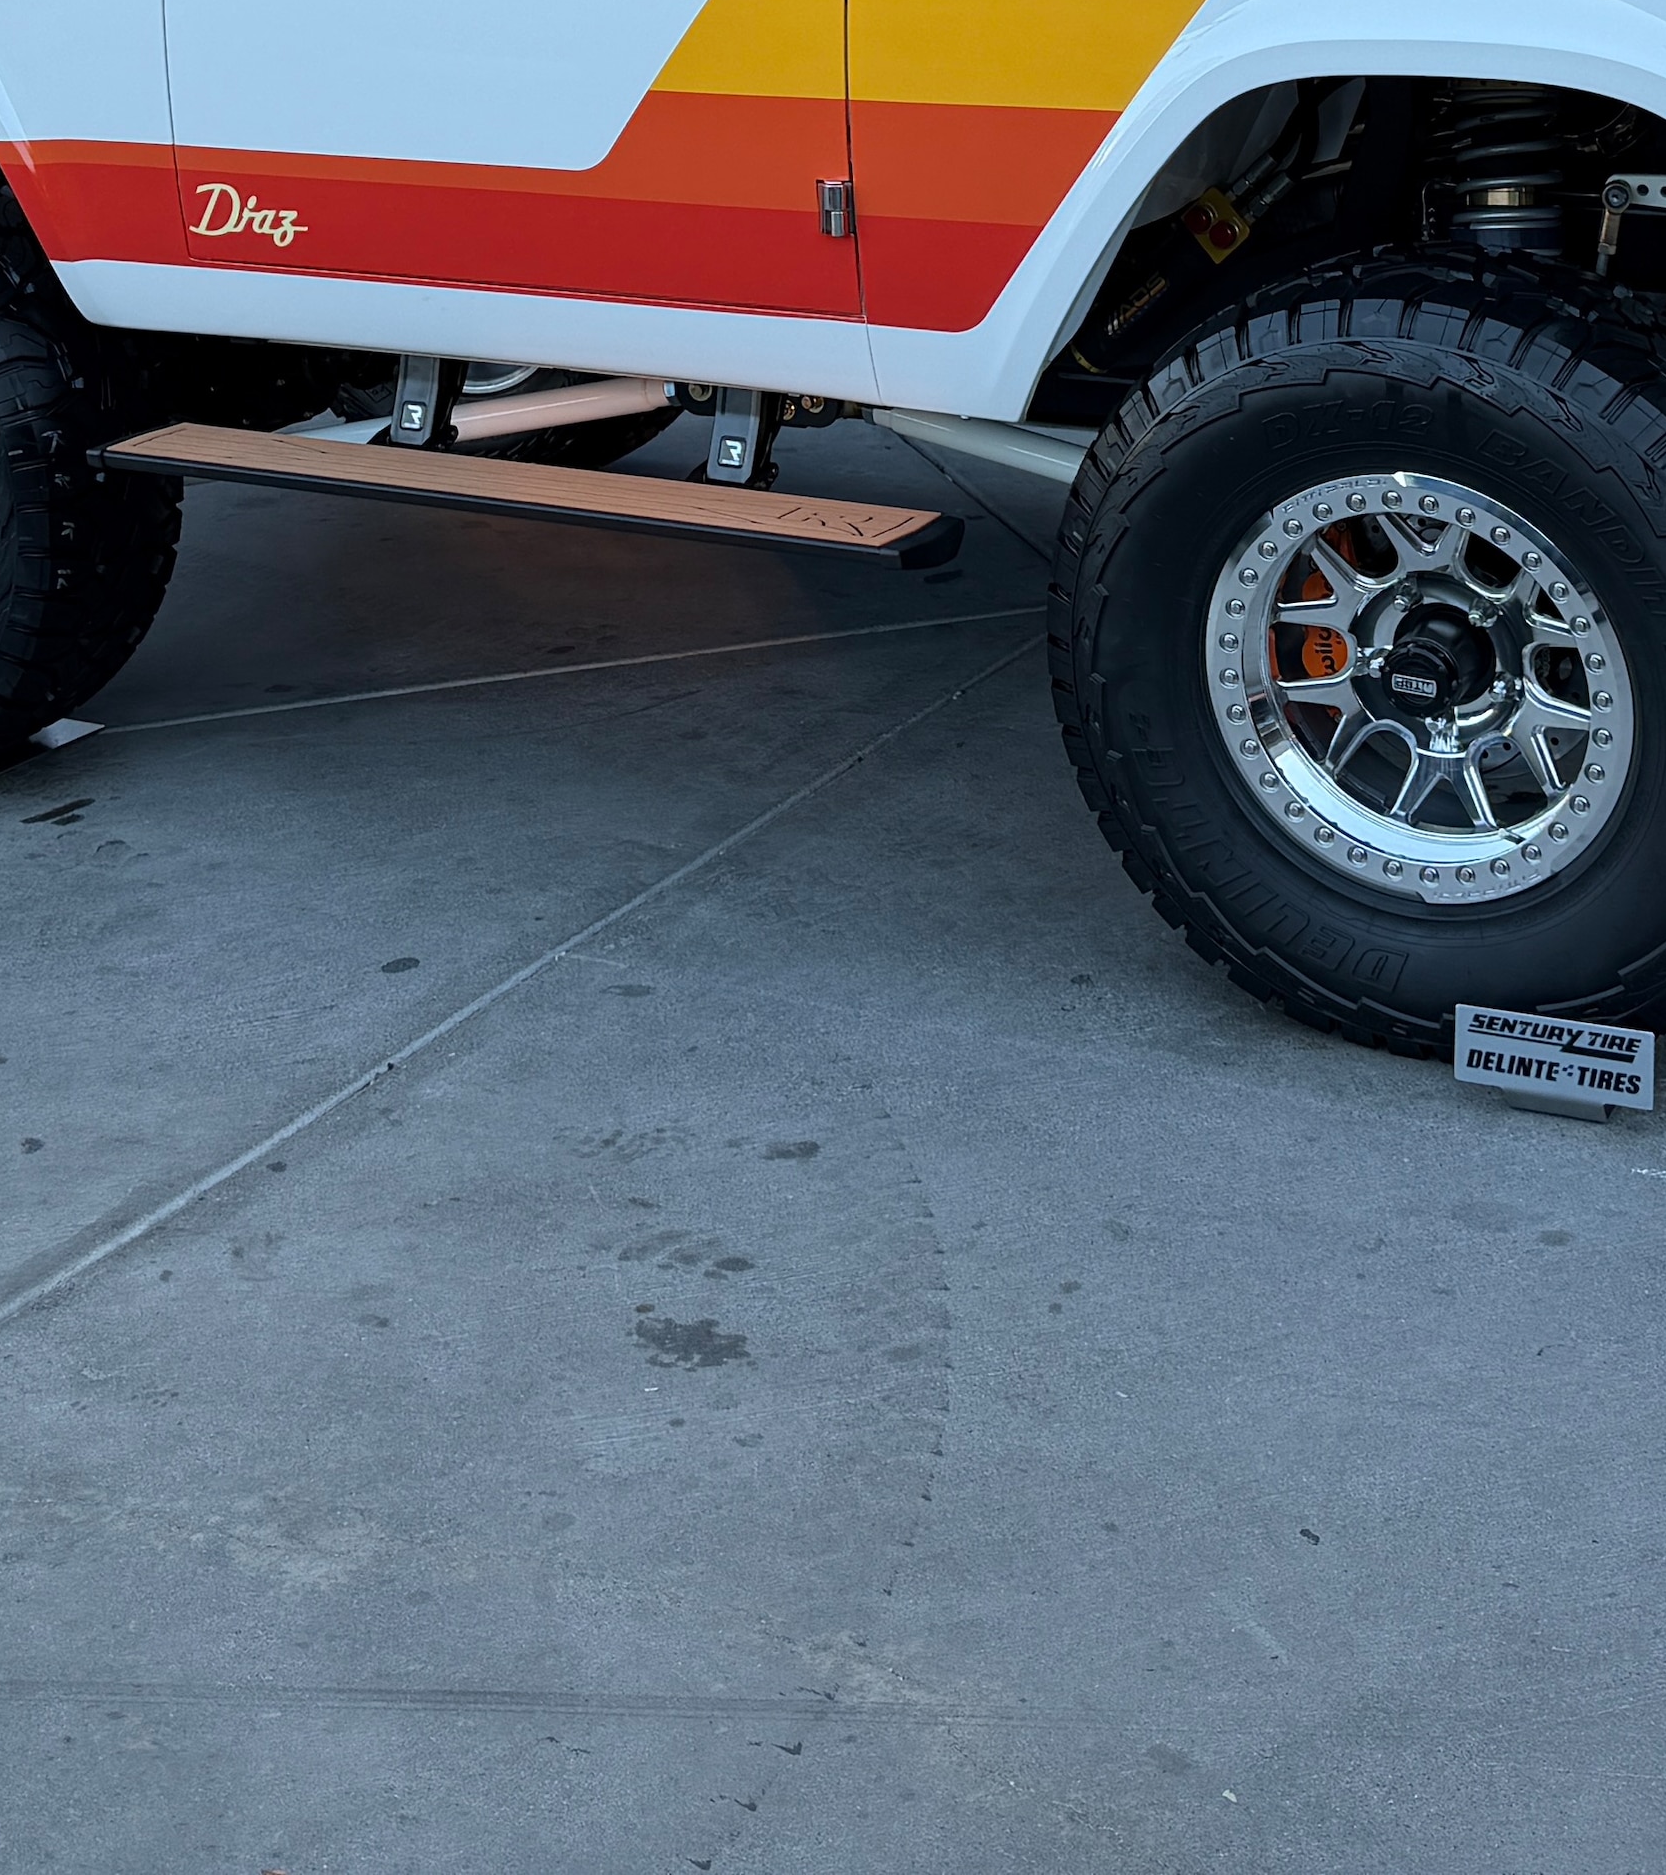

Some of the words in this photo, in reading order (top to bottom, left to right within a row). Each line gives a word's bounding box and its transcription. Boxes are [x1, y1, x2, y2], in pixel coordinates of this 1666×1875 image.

[188, 181, 309, 248] Diaz
[1262, 399, 1436, 452] DX-12
[1468, 1013, 1585, 1050] SENTURY
[1588, 1031, 1642, 1054] TIRE
[1466, 1048, 1560, 1082] DELINTE
[1577, 1065, 1642, 1095] TIRES
